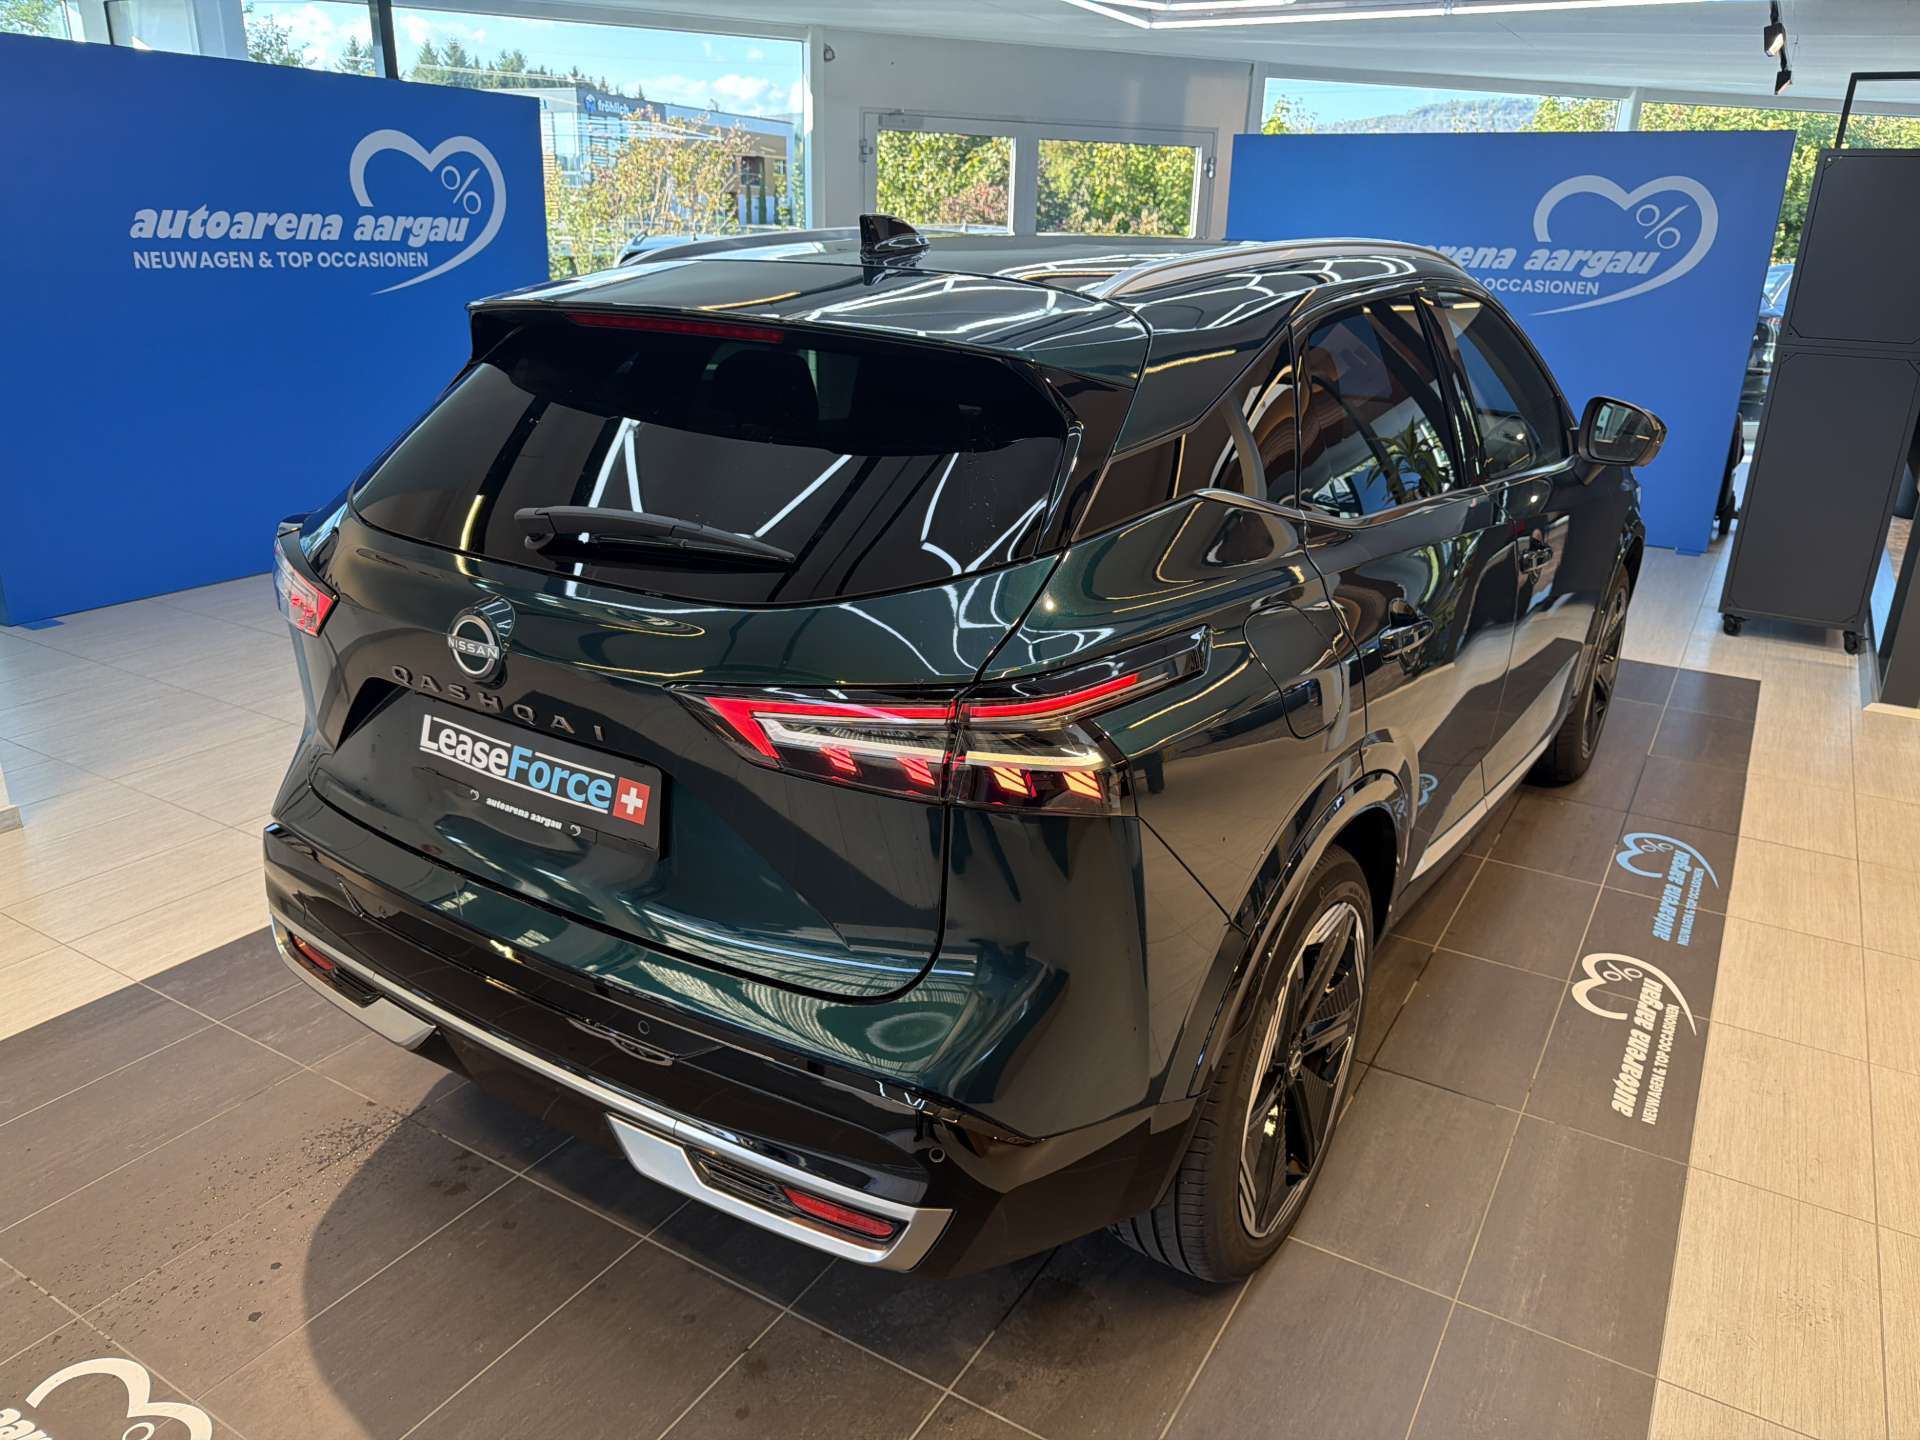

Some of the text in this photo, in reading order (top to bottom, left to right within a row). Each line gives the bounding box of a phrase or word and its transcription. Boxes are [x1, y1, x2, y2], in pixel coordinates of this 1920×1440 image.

[130, 204, 470, 248] autoarena aargau
[133, 251, 429, 269] NEUWAGEN & TOP OCCASIONEN
[1523, 248, 1660, 278] aargau
[1482, 277, 1600, 296] OCCASIONEN
[447, 635, 499, 659] NISSAN
[391, 664, 605, 742] QASHQAI
[419, 713, 613, 809] LeaseForce
[485, 797, 563, 830] autoarena aargau
[1652, 883, 1682, 942] autoarena
[1611, 977, 1664, 1118] autoarena aargau
[1657, 1003, 1680, 1052] OCCASIONEN
[1654, 1051, 1670, 1068] TOP
[1641, 1073, 1666, 1125] NEUWAGEN
